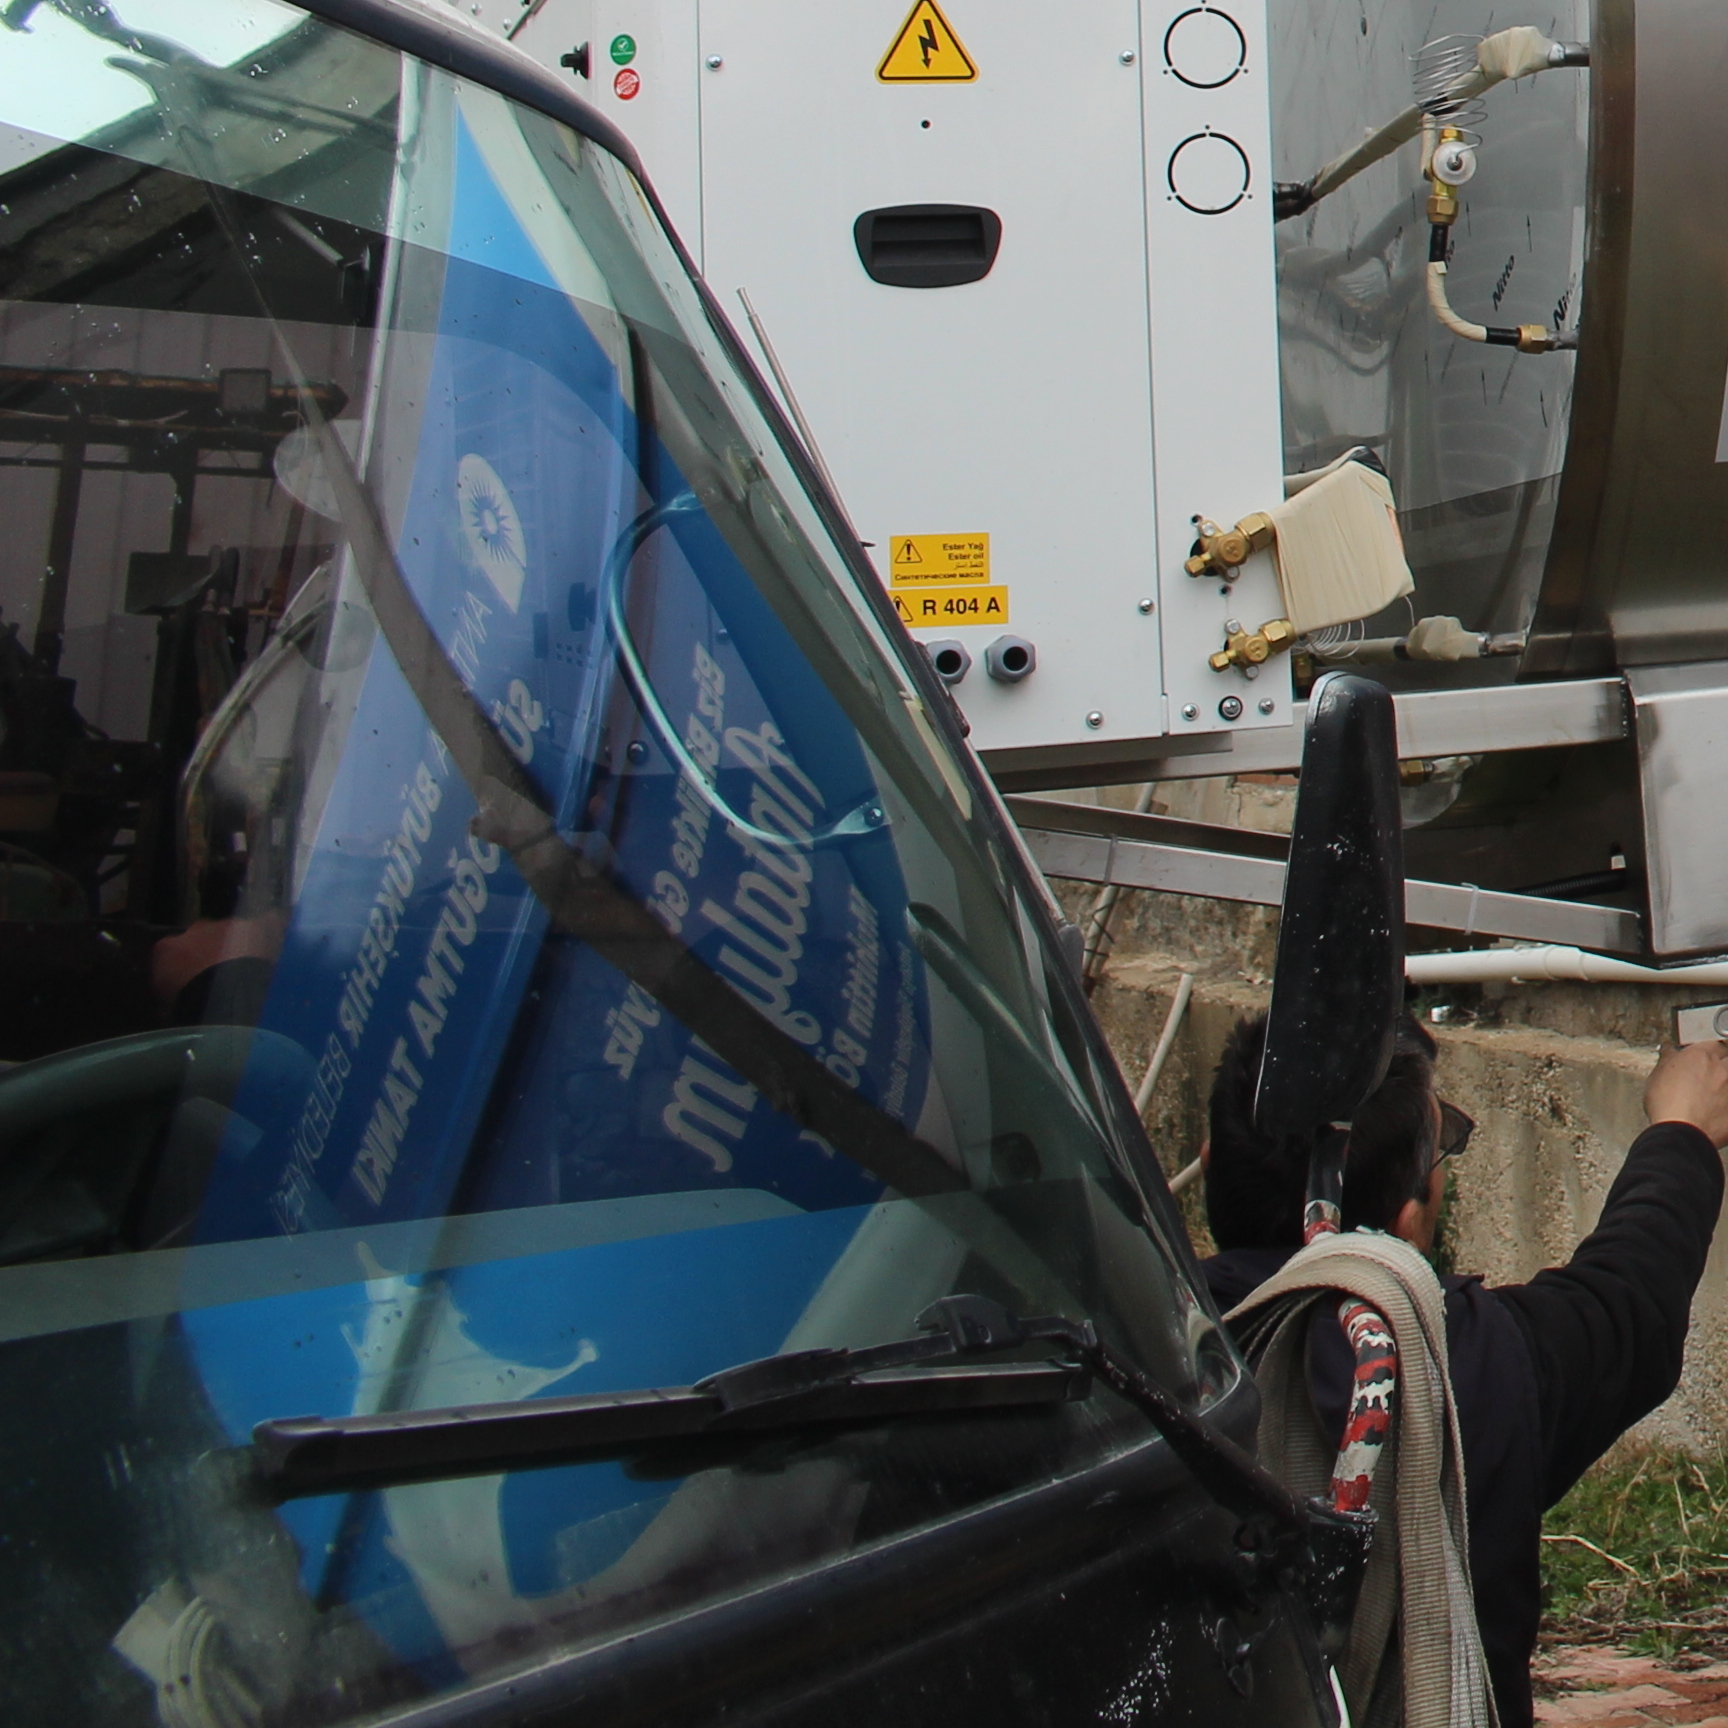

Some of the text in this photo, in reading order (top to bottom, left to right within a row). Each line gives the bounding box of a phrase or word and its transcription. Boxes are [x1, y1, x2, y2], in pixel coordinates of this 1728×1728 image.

[1492, 254, 1515, 313] Nitto
[942, 542, 985, 552] Ester Yağ
[948, 552, 985, 561] Ester oil
[922, 596, 1001, 616] R 404 A
